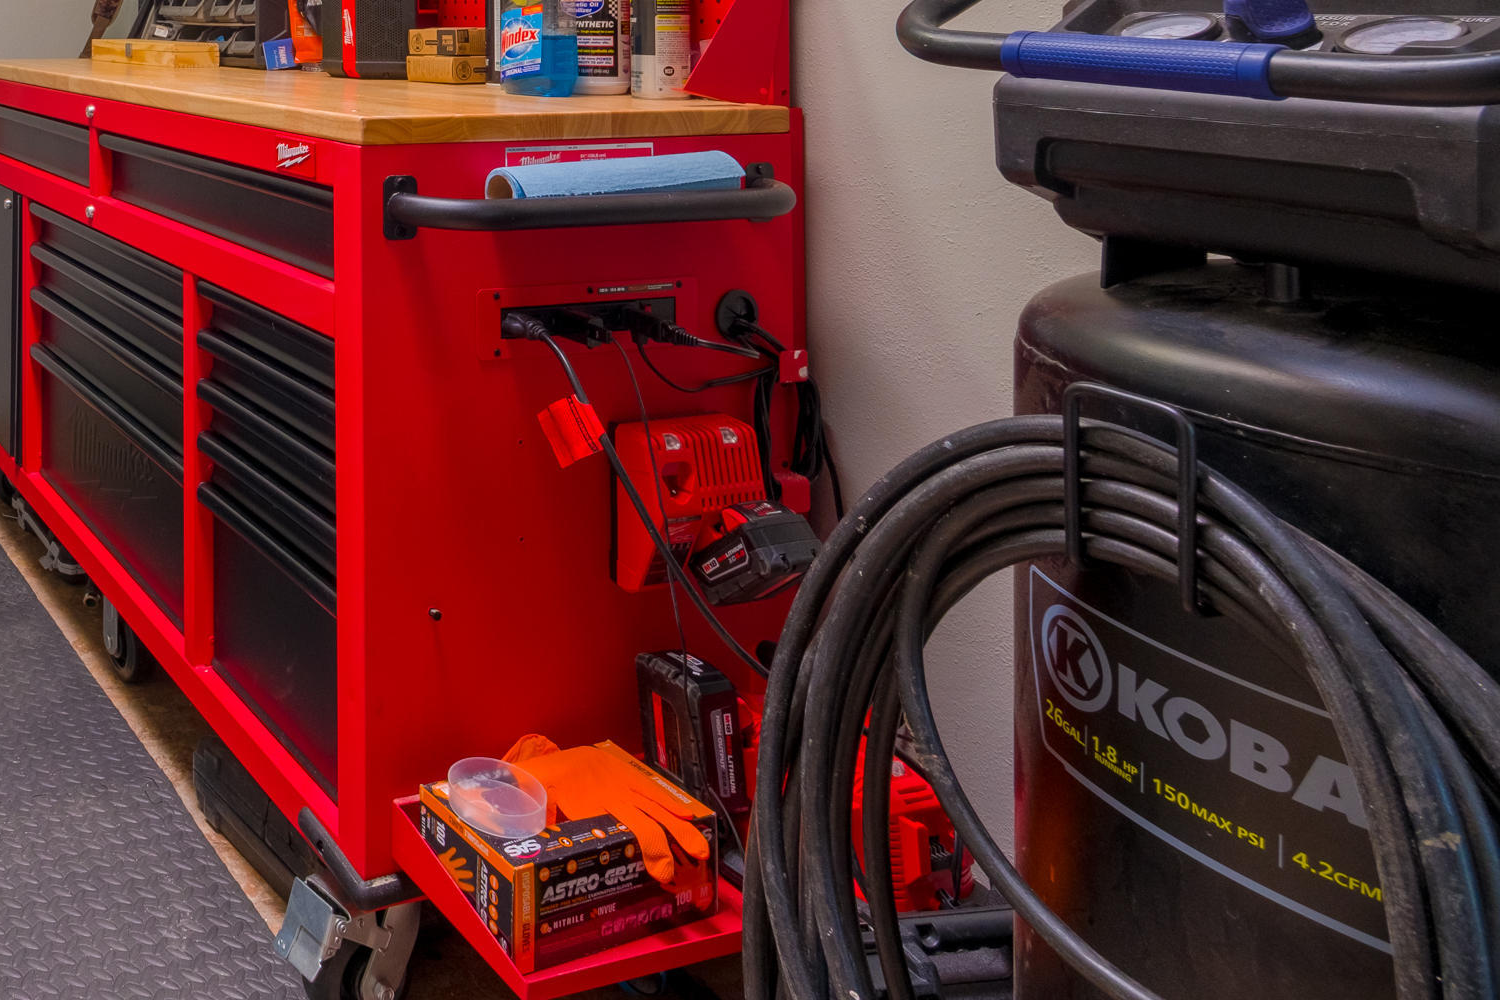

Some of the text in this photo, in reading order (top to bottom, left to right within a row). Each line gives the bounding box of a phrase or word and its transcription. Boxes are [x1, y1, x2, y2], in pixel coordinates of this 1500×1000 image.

[276, 142, 310, 161] Milwaukee
[520, 152, 561, 166] Milwaukee
[703, 560, 718, 573] M18
[717, 737, 726, 769] OUTPUT
[1118, 663, 1368, 830] KOBA
[1045, 698, 1086, 747] 26GAL
[1092, 736, 1117, 763] 1.8
[1123, 760, 1138, 775] HP
[1236, 826, 1265, 850] PSI
[1094, 752, 1132, 784] RUNNING
[436, 819, 446, 847] 100
[503, 839, 541, 857] SAS
[480, 860, 488, 926] ASTRO-G
[522, 871, 531, 922] DISPOSABLE
[541, 861, 645, 904] ASTRO-GRIP
[675, 889, 692, 906] 100
[553, 913, 584, 929] NITRILE
